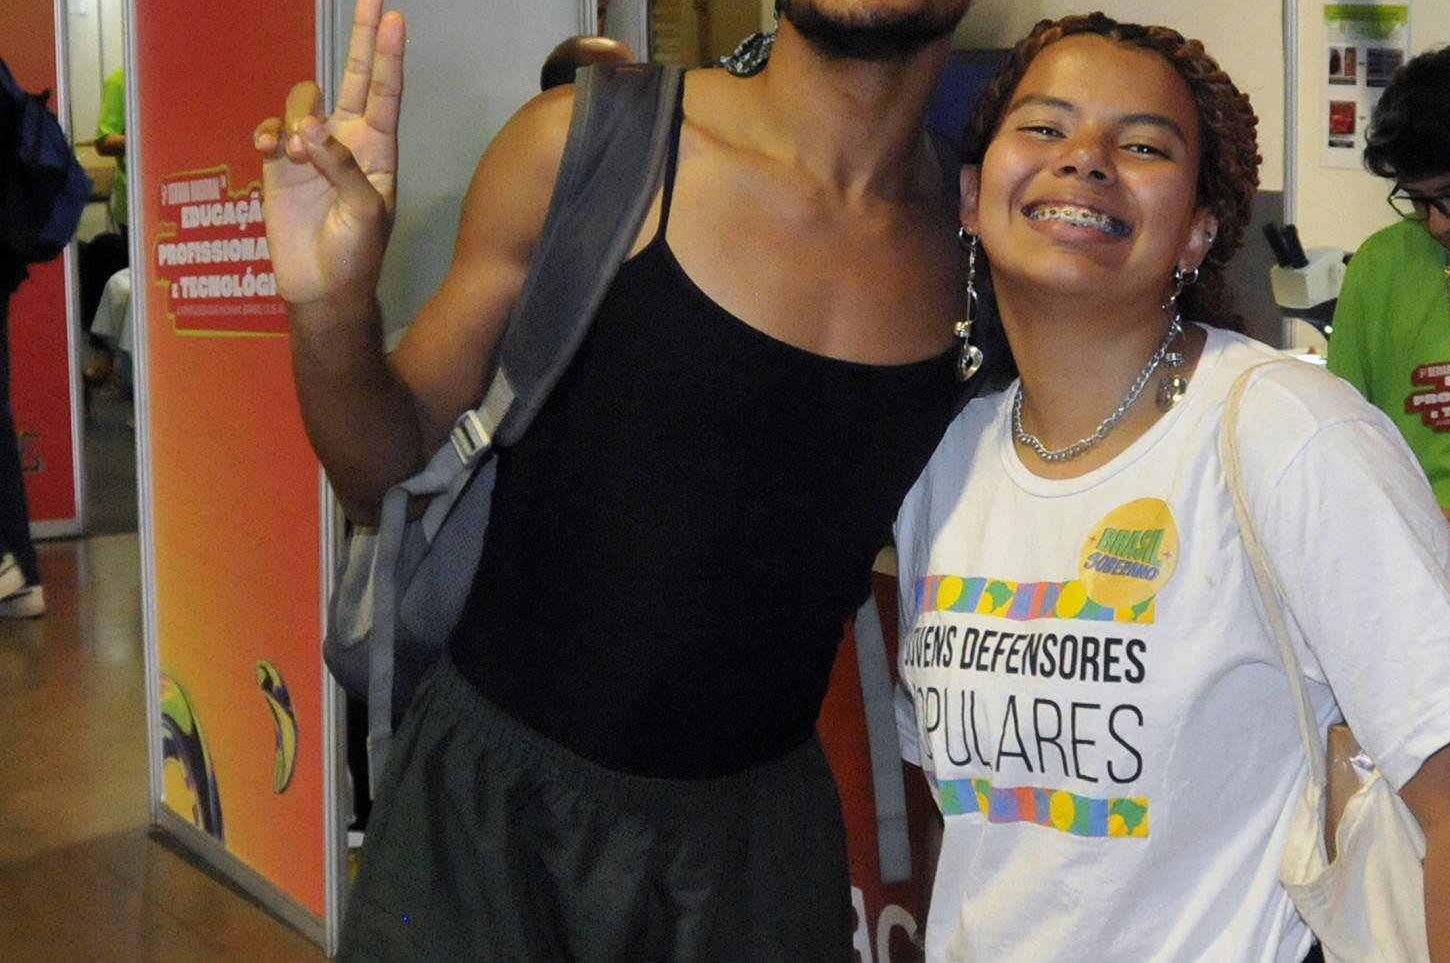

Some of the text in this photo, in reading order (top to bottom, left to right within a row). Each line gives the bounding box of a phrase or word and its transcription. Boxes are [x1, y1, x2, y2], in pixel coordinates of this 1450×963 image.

[181, 191, 264, 231] EDUCAÇÃ
[158, 237, 271, 266] PROFISSIONA
[179, 266, 276, 299] TECNOLÓGI
[960, 628, 1147, 684] DEFENSORES
